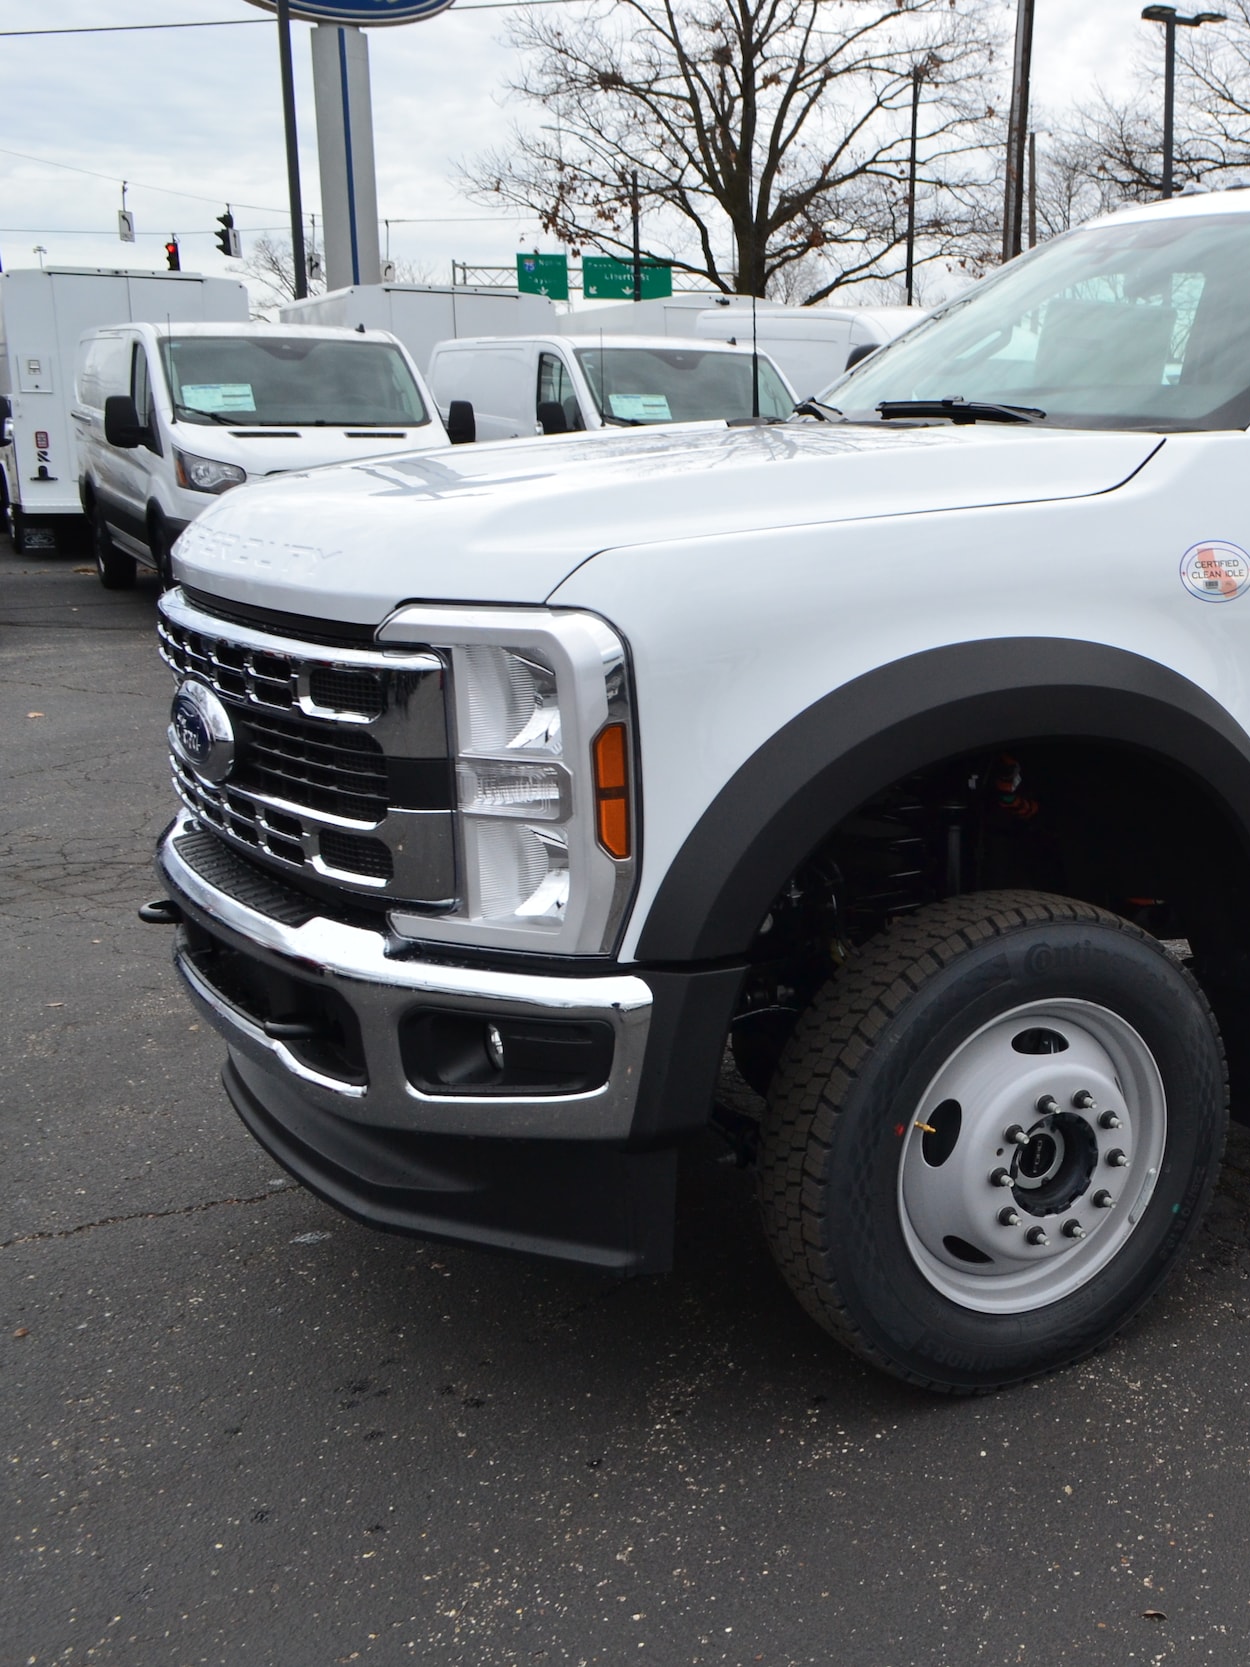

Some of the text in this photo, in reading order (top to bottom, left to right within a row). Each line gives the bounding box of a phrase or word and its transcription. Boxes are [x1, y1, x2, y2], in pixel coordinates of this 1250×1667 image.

[1194, 559, 1240, 569] CERTIFIED
[1191, 569, 1245, 579] CLEAN IDLE
